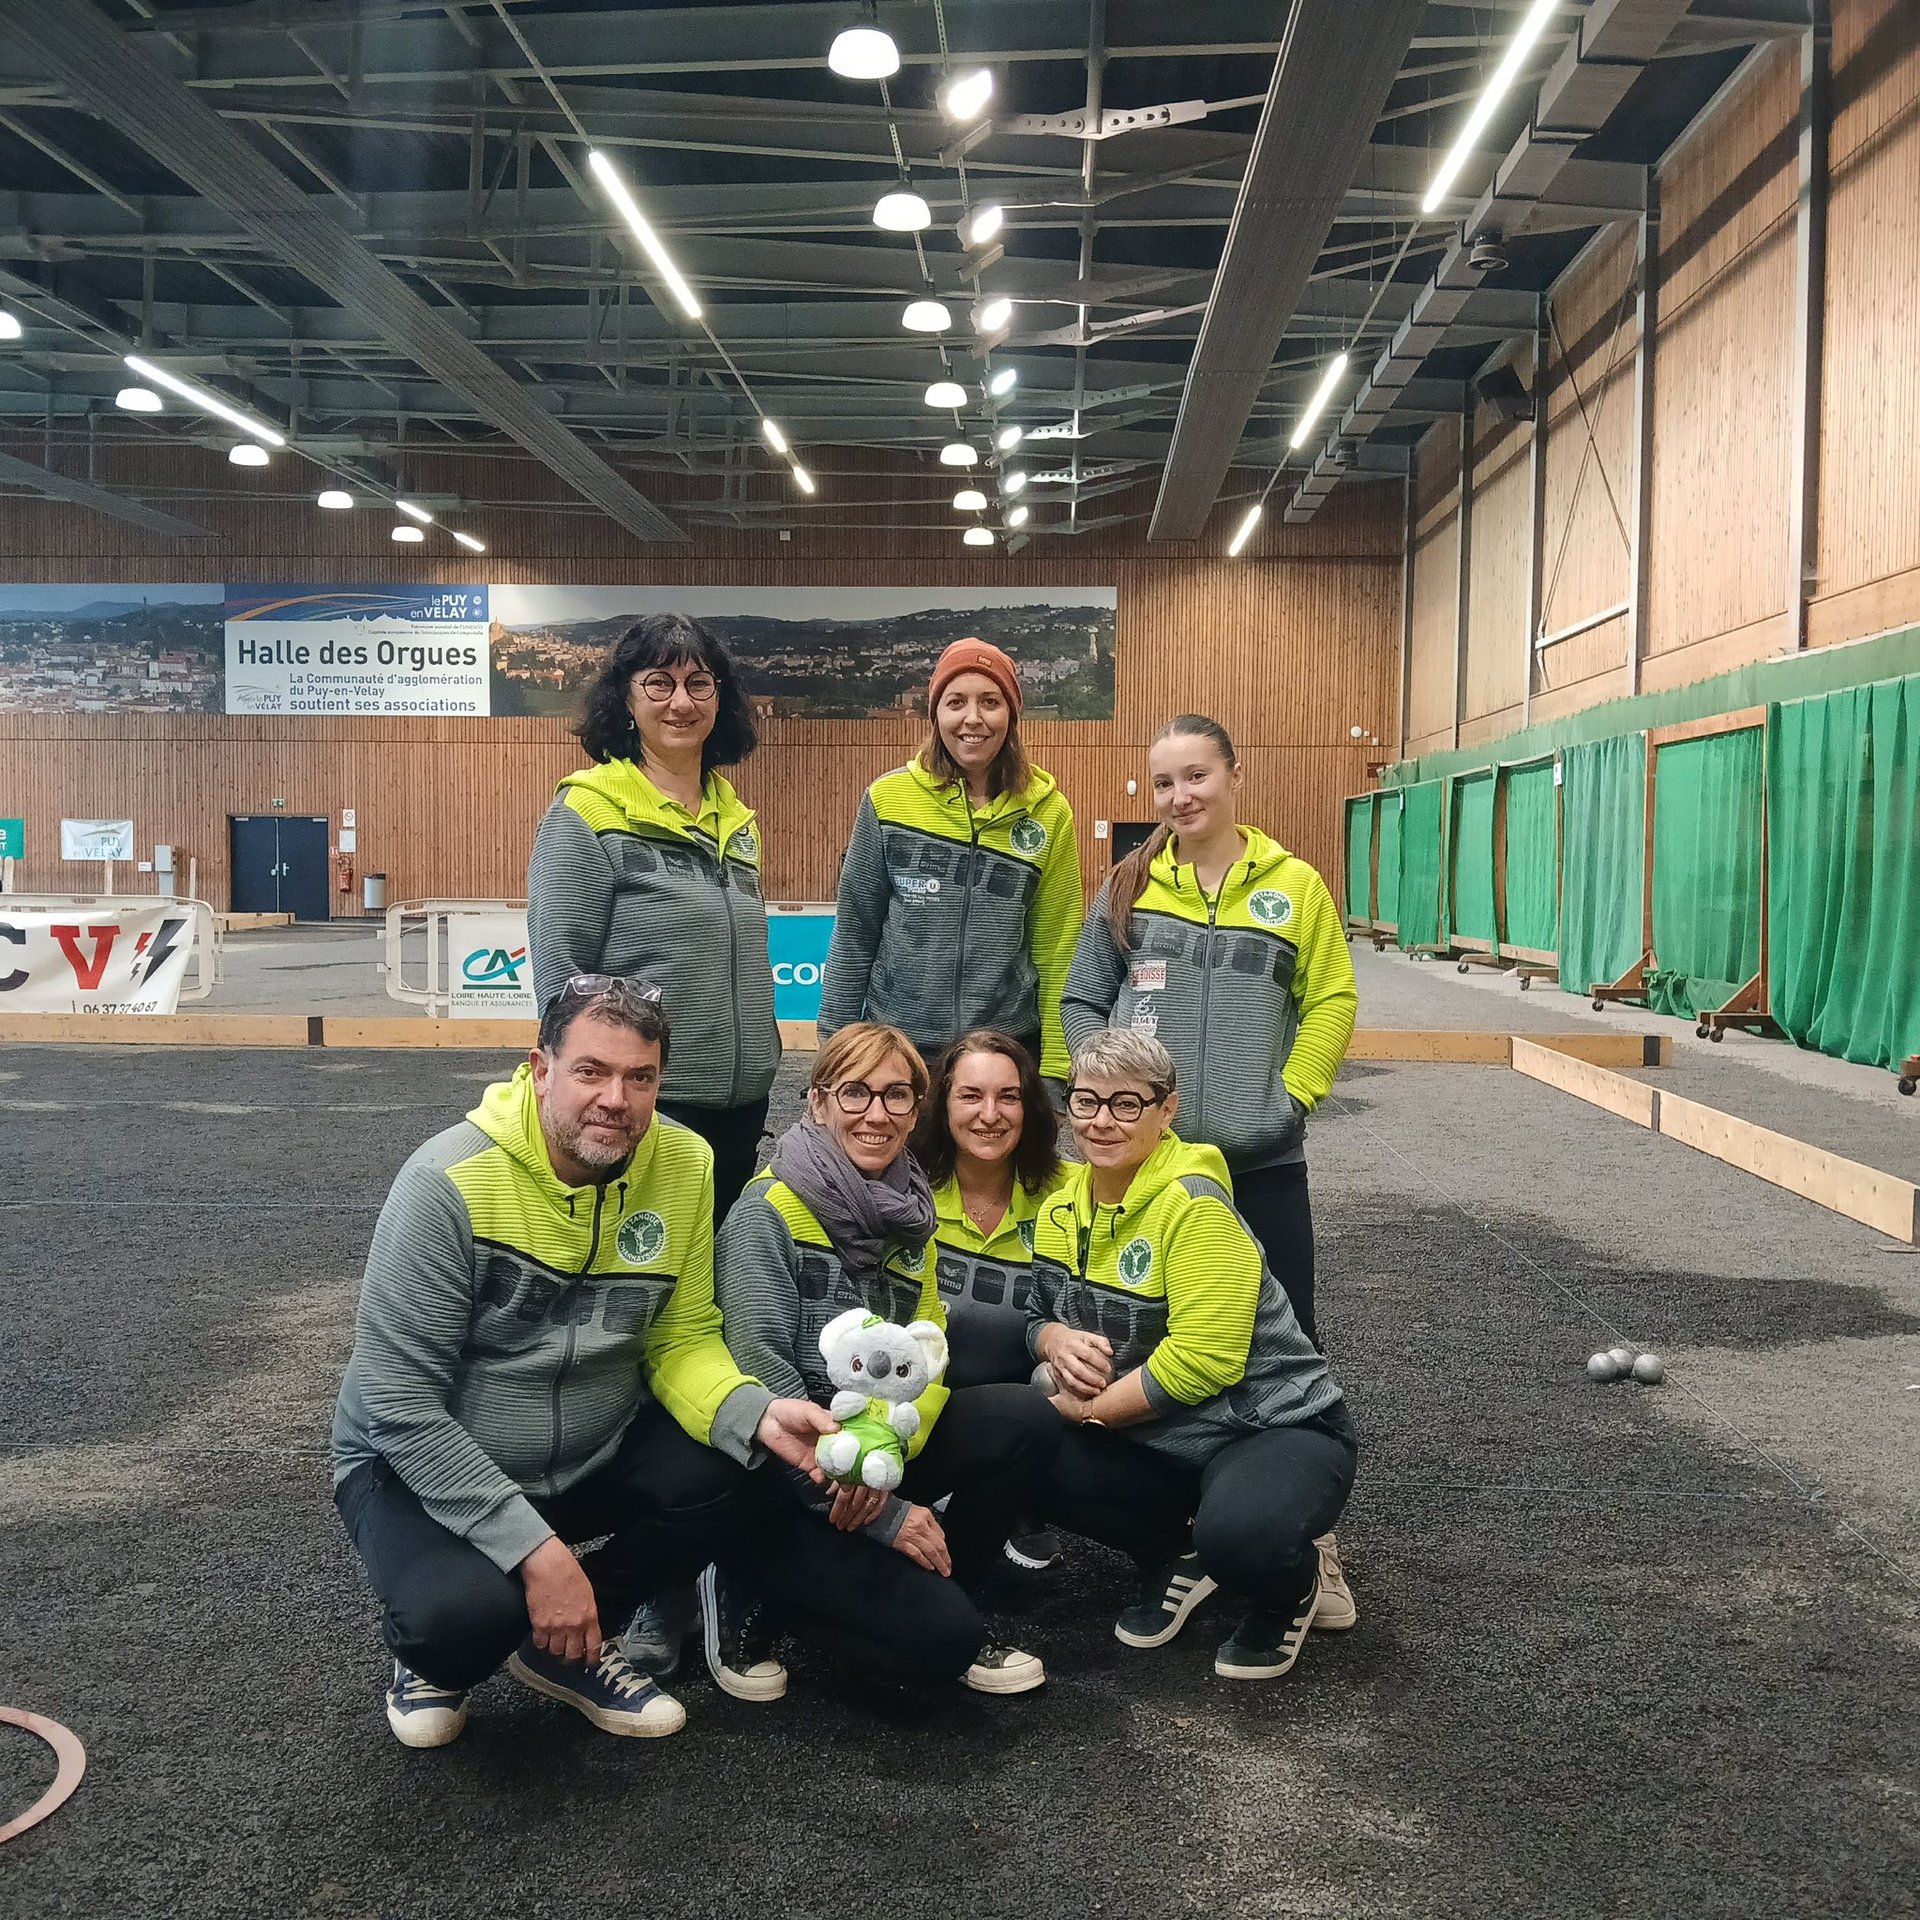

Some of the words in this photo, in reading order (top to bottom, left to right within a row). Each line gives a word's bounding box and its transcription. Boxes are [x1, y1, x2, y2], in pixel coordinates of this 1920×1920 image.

[238, 639, 310, 665] Halle
[319, 640, 368, 665] des
[377, 640, 477, 672] Orgues
[290, 673, 304, 684] La
[306, 673, 384, 684] Communauté
[387, 673, 482, 686] d'agglomération
[290, 685, 304, 696] du
[307, 685, 385, 698] Puy-en-Velay
[290, 698, 351, 711] soutient
[354, 701, 380, 711] ses
[384, 699, 476, 711] associations
